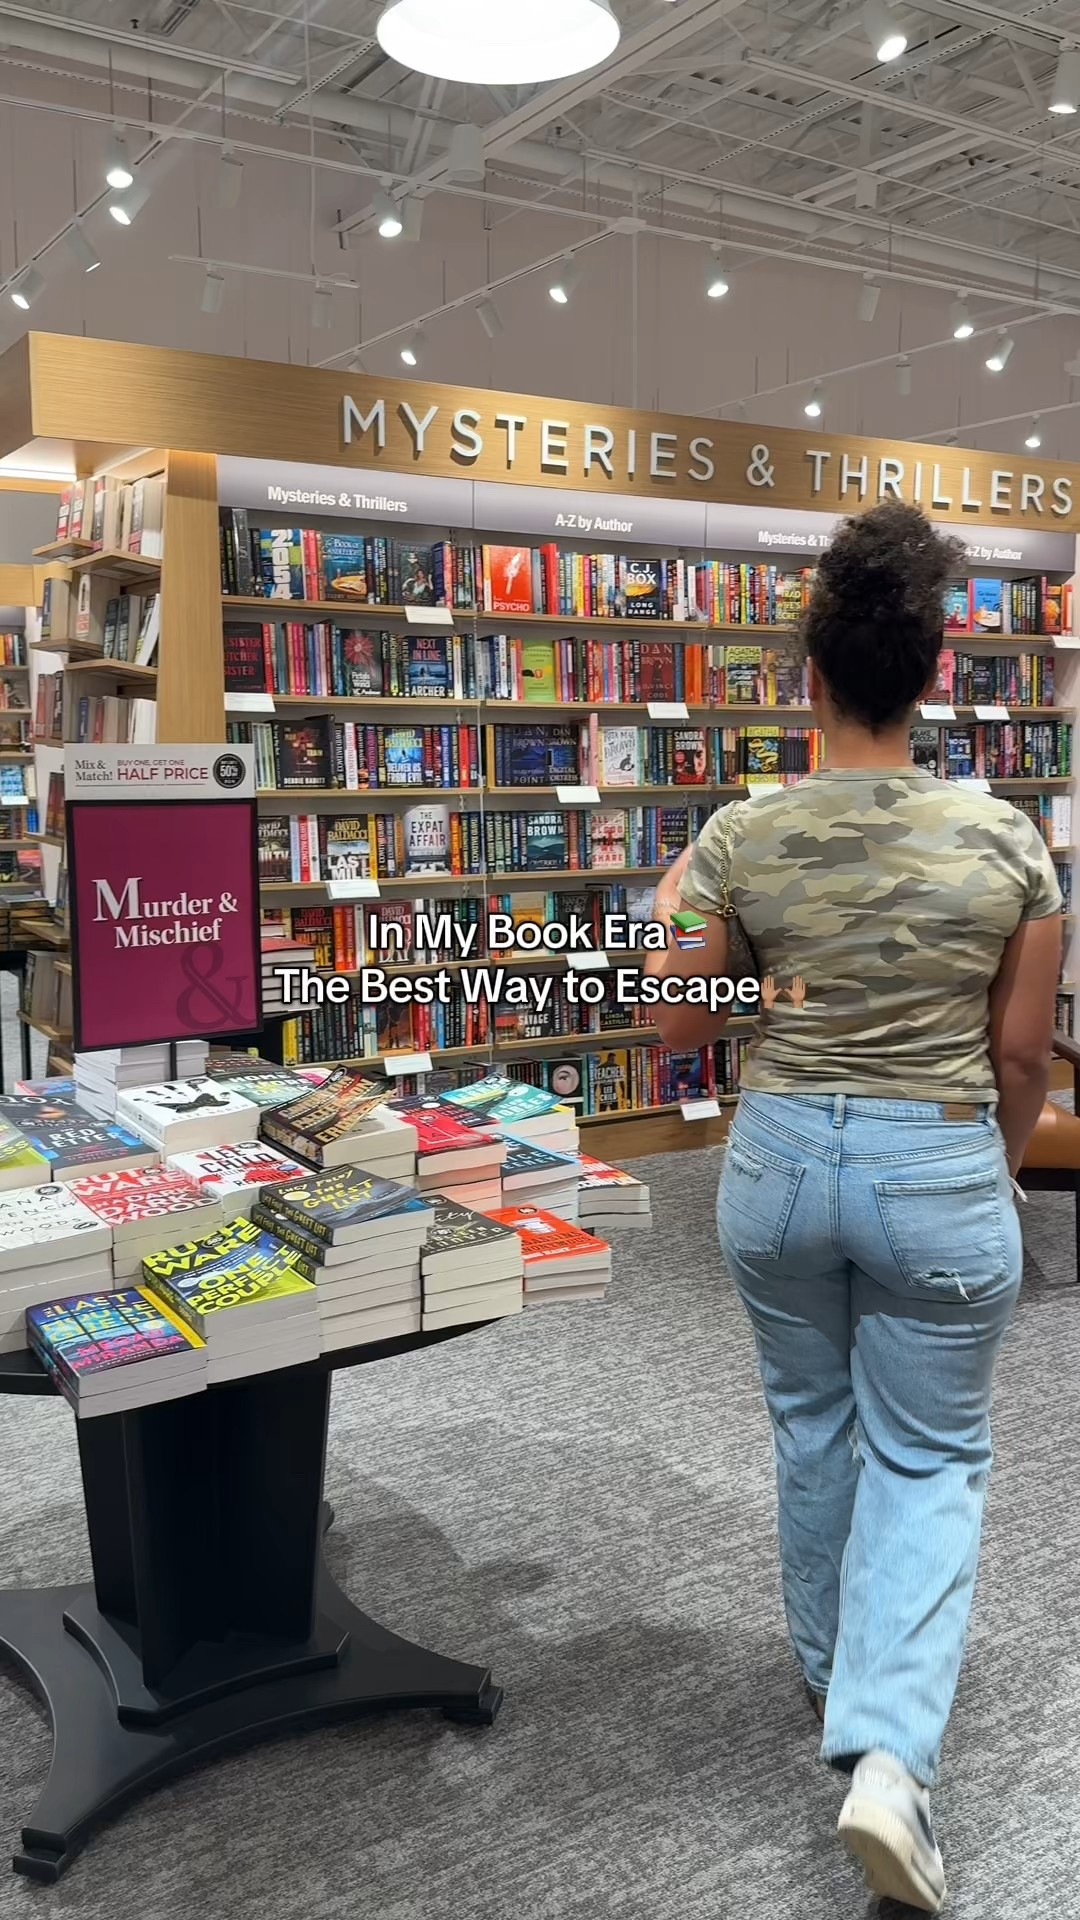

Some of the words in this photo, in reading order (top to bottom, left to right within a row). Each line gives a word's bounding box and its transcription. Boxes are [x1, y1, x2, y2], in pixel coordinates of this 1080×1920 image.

[343, 395, 715, 481] MYSTERIES
[746, 444, 775, 487] &
[805, 450, 1073, 515] THRILLERS
[268, 486, 336, 505] Mysteries
[338, 493, 352, 507] &
[353, 494, 408, 513] Thrillers
[555, 514, 577, 528] A-Z
[577, 516, 592, 532] by
[594, 517, 633, 533] Author
[758, 531, 806, 546] Mysteries
[807, 534, 818, 547] &
[980, 548, 993, 561] by
[992, 548, 1023, 561] Author
[630, 562, 654, 574] C.J.
[627, 573, 657, 585] BOX
[493, 601, 530, 613] PSYCHO
[416, 638, 437, 650] NEXT
[640, 643, 673, 654] DAN
[412, 650, 422, 661] IN
[422, 650, 441, 661] LINE
[728, 647, 761, 656] AGATHA
[411, 686, 446, 697] ARCHER
[674, 730, 704, 741] SANDRA
[674, 740, 704, 751] BROWN
[75, 760, 96, 770] Mix
[97, 760, 106, 770] &
[388, 763, 411, 773] DELIVER
[75, 771, 113, 782] Match!
[117, 768, 159, 781] HALF
[164, 767, 209, 780] PRICE
[388, 772, 407, 783] FROM
[407, 772, 424, 783] EVIL
[513, 776, 545, 784] POINT
[419, 812, 433, 820] THE
[528, 815, 563, 825] SANDRA
[335, 821, 360, 831] DAVID
[411, 820, 445, 834] EXPAT
[527, 825, 563, 837] BROWN
[327, 829, 368, 841] BALDACCI
[409, 834, 447, 848] AFFAIR
[327, 855, 370, 870] LAST
[592, 854, 624, 863] SHARE
[332, 867, 371, 880] MILE
[91, 877, 214, 922] Murder
[218, 892, 239, 913] &
[114, 917, 223, 949] Mischief
[518, 1013, 550, 1025] SAVAGE
[525, 1027, 542, 1037] SON
[229, 1072, 292, 1084] HOME
[603, 1086, 613, 1094] LEE
[48, 1128, 97, 1141] RED
[39, 1132, 122, 1151] LETTER
[204, 1149, 247, 1161] LEE
[200, 1153, 278, 1174] CHILD
[65, 1164, 166, 1190] RUT
[75, 1170, 186, 1196] WARE
[233, 1171, 294, 1186] REACHER
[303, 1179, 373, 1209] GUEST
[331, 1189, 372, 1211] LIST
[97, 1195, 195, 1220] DARK
[105, 1197, 222, 1225] WOOD
[0, 1218, 82, 1237] WOODS
[152, 1227, 262, 1276] WARE
[187, 1244, 288, 1306] PERFECT
[198, 1252, 267, 1290] ONE
[197, 1253, 303, 1315] COUPLE
[53, 1292, 129, 1315] LAST
[42, 1300, 151, 1332] HOUSE
[51, 1309, 158, 1344] GUEST
[77, 1328, 166, 1357] MEGAN
[71, 1335, 185, 1371] MIRANDA
